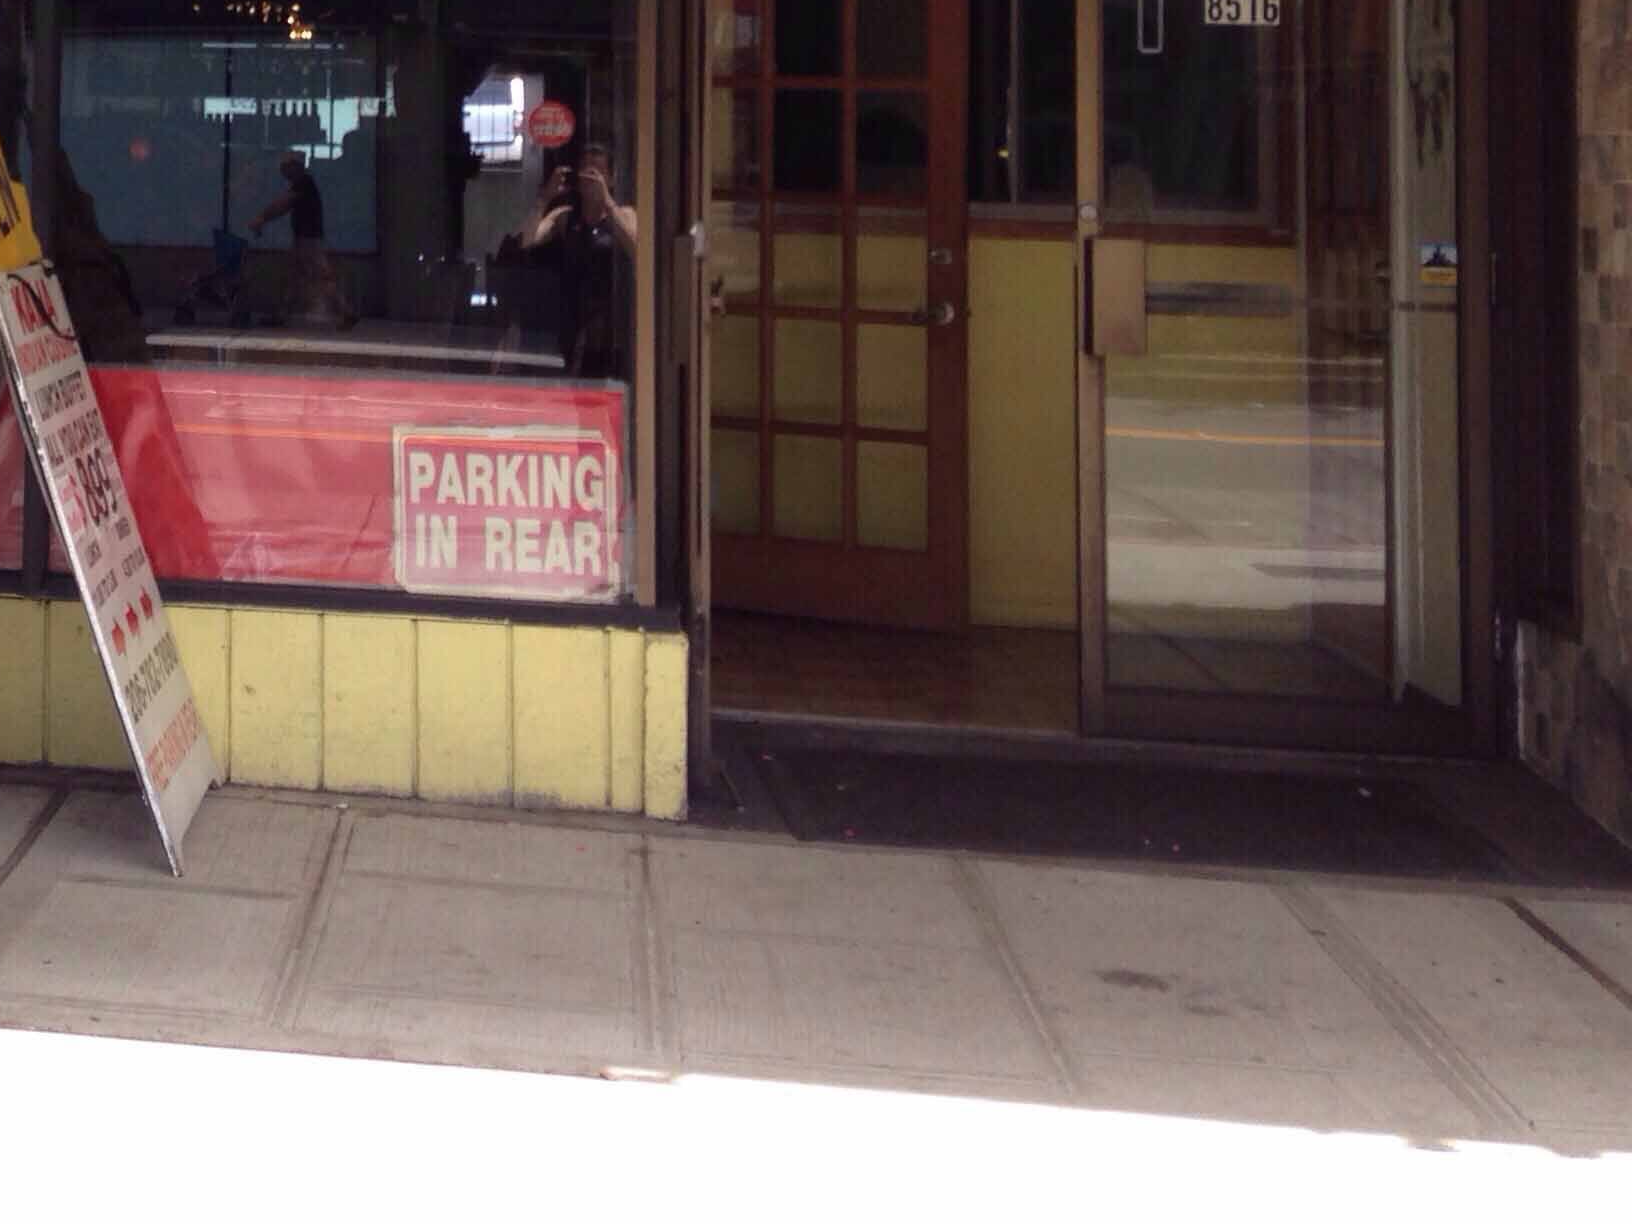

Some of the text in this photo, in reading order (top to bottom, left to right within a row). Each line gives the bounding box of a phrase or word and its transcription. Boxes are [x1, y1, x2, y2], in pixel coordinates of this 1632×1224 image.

[408, 451, 605, 512] PARKING
[415, 514, 603, 576] IN REAR
